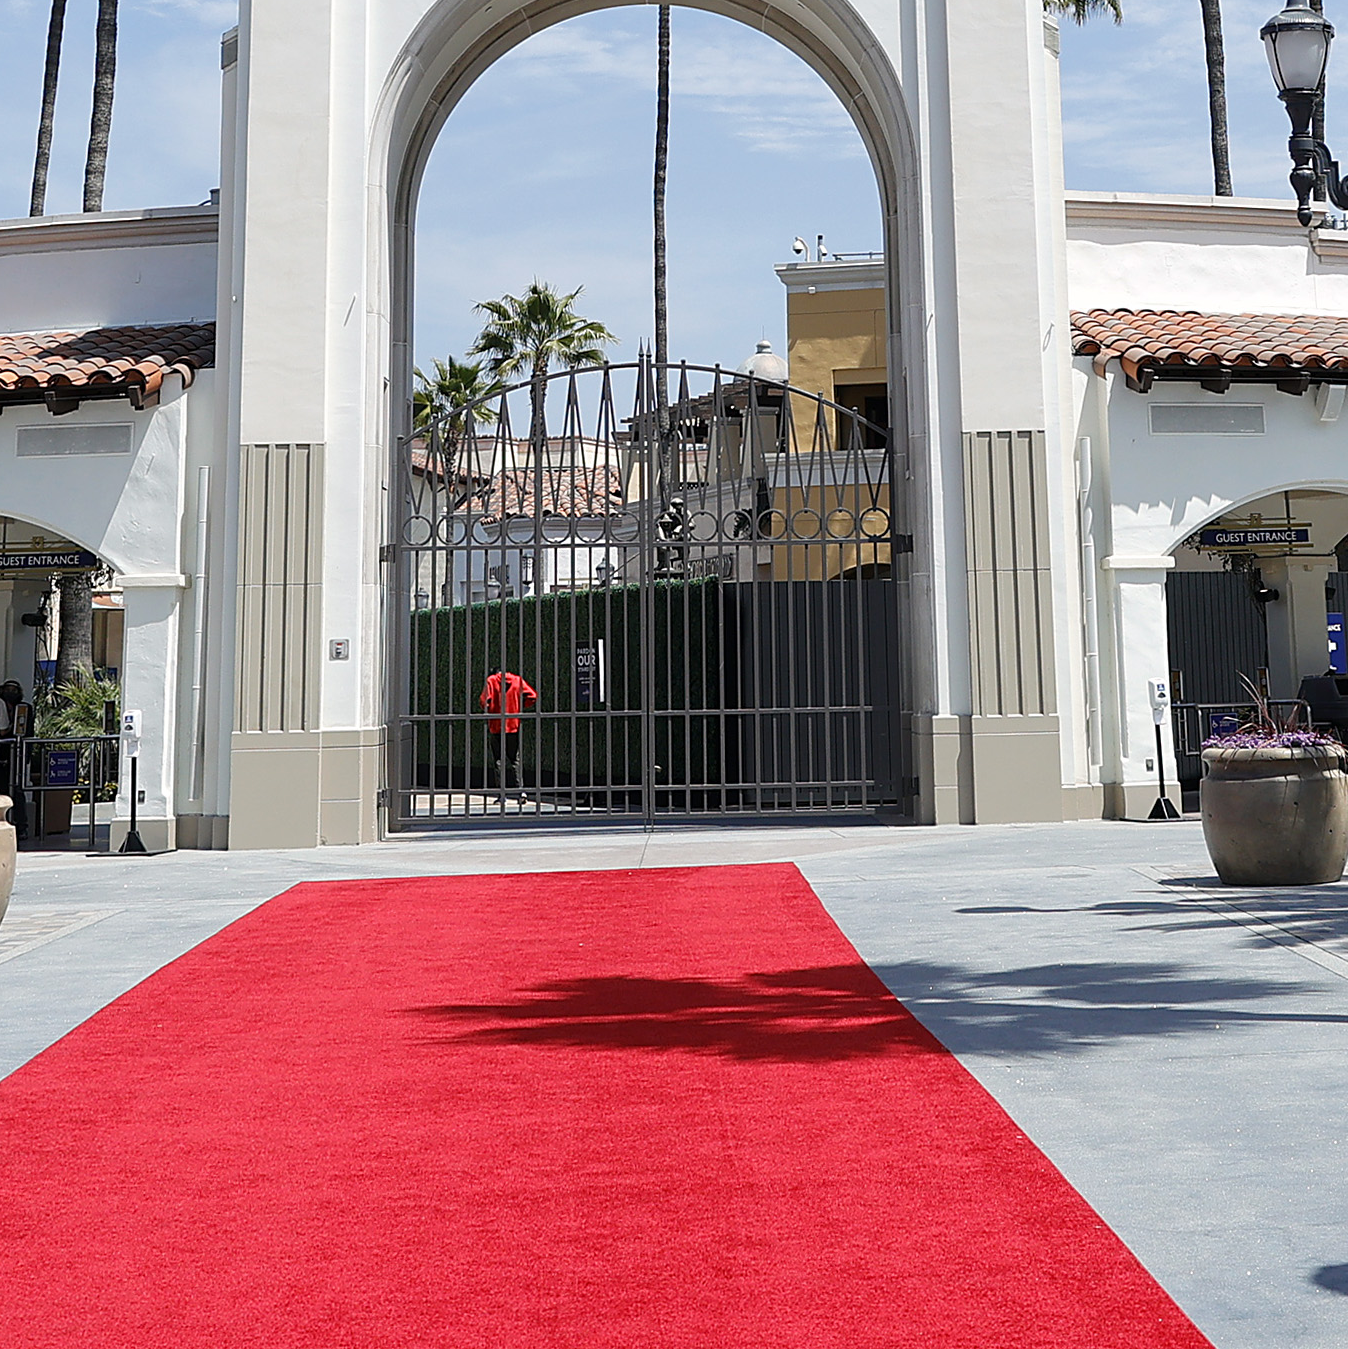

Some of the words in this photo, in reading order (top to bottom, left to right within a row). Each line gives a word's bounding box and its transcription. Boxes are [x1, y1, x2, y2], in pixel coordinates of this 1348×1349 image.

[1215, 533, 1245, 543] GUEST
[1247, 531, 1298, 543] ENTRANCE
[28, 554, 80, 566] ENTRANCE
[577, 655, 596, 666] OUR
